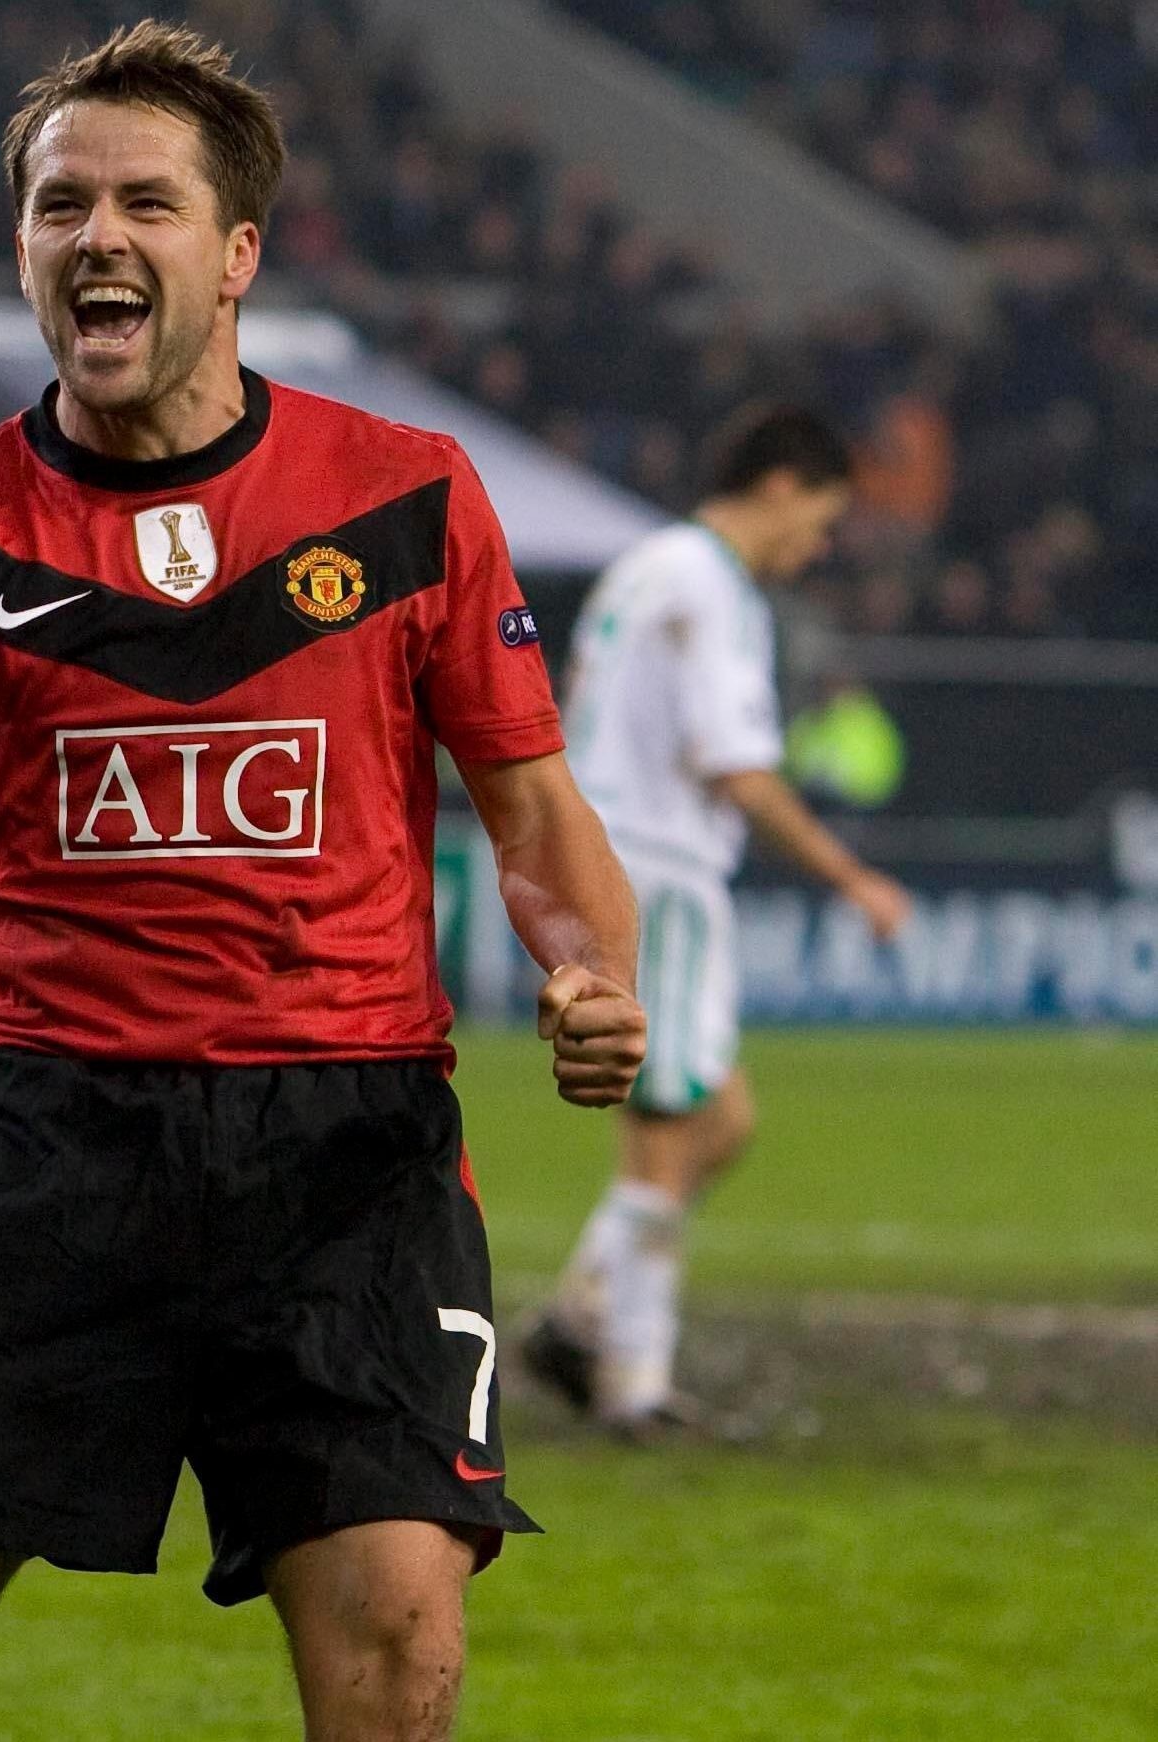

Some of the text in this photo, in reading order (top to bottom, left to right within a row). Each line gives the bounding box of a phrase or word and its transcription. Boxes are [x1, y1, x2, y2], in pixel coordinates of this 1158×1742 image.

[165, 564, 198, 578] FIFA
[294, 551, 358, 576] MANCHESTER
[307, 603, 352, 617] UNITED
[74, 737, 310, 844] AIG
[437, 1307, 496, 1445] 7
